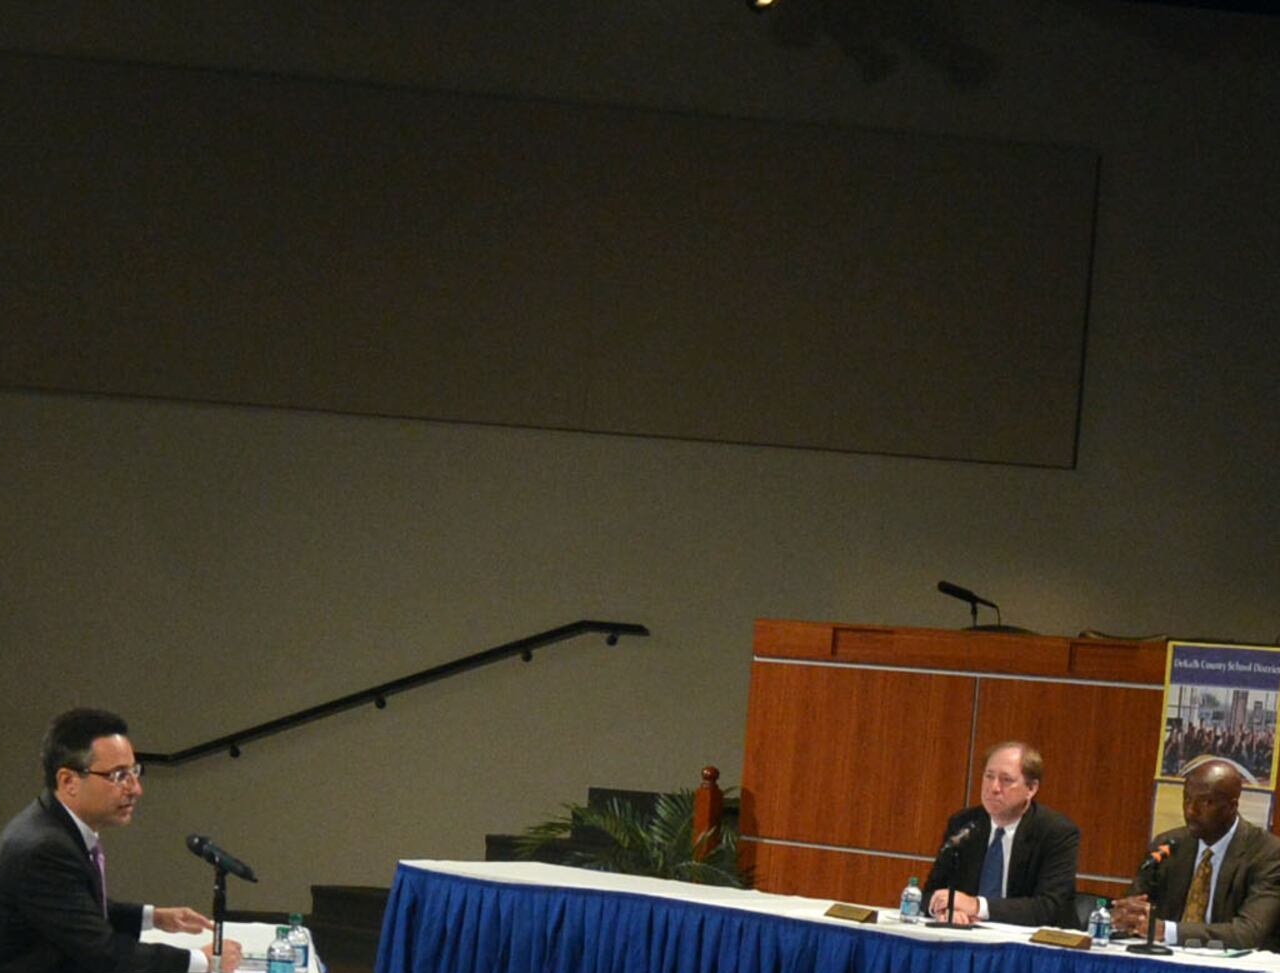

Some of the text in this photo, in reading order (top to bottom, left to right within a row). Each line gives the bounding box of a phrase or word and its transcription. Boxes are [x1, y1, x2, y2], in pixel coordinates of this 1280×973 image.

[1201, 660, 1226, 673] County
[1228, 661, 1252, 673] School
[1253, 663, 1280, 674] District
